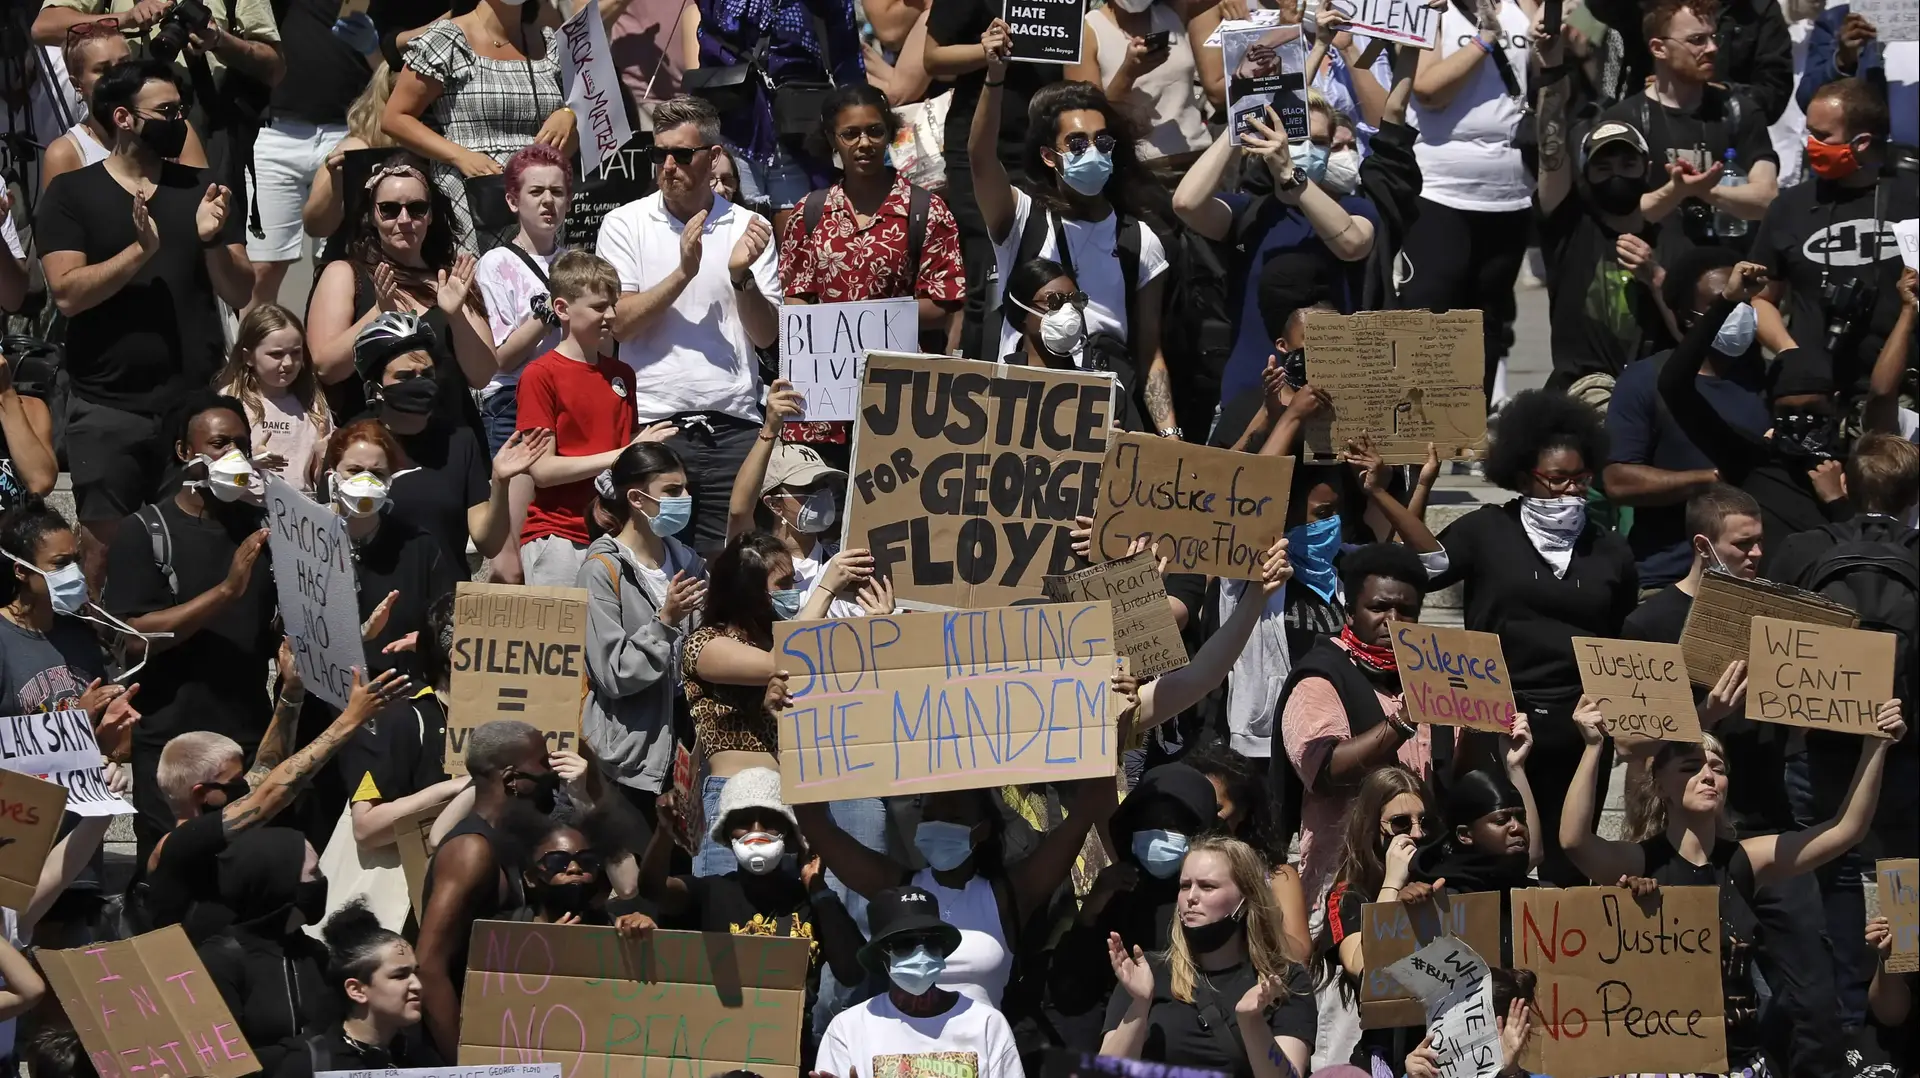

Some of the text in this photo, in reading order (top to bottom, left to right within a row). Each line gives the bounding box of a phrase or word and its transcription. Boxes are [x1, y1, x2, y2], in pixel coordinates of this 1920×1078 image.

[1010, 23, 1069, 38] RACISTS.
[1011, 6, 1045, 19] HATE
[1282, 107, 1305, 116] BLACK
[1286, 127, 1306, 135] ATTER
[787, 308, 903, 356] BLACK
[262, 421, 290, 430] DANCE
[863, 368, 1110, 453] JUSTICE
[854, 447, 1102, 521] FOR GEORGE
[1108, 442, 1273, 517] Justice for
[274, 498, 345, 573] RACISM
[296, 559, 327, 607] HAS
[1102, 563, 1160, 597] hearts
[302, 604, 330, 650] NO
[459, 594, 580, 634] WHITE
[453, 637, 581, 678] SILENCE
[782, 605, 1107, 699] STOP KILLING
[1126, 635, 1162, 656] break
[1141, 649, 1170, 667] free
[1397, 627, 1502, 684] Silence
[1585, 643, 1679, 683] Justice
[1764, 625, 1820, 660] WE
[296, 634, 350, 703] PLACE
[1775, 662, 1862, 691] CAN'T
[1631, 682, 1647, 706] 4
[0, 710, 100, 760] LACK SKIN
[783, 701, 875, 783] THE
[893, 677, 1107, 781] MANDEM
[1595, 697, 1679, 739] George
[1522, 893, 1713, 965] No Justice
[85, 948, 125, 984] I
[481, 929, 792, 1008] NO JUSTICE
[1410, 956, 1456, 991] #BLM
[1444, 950, 1487, 1037] WHITE
[1528, 979, 1708, 1042] No Peace
[501, 1003, 783, 1078] NO PEACE
[488, 1066, 516, 1077] GEORGE
